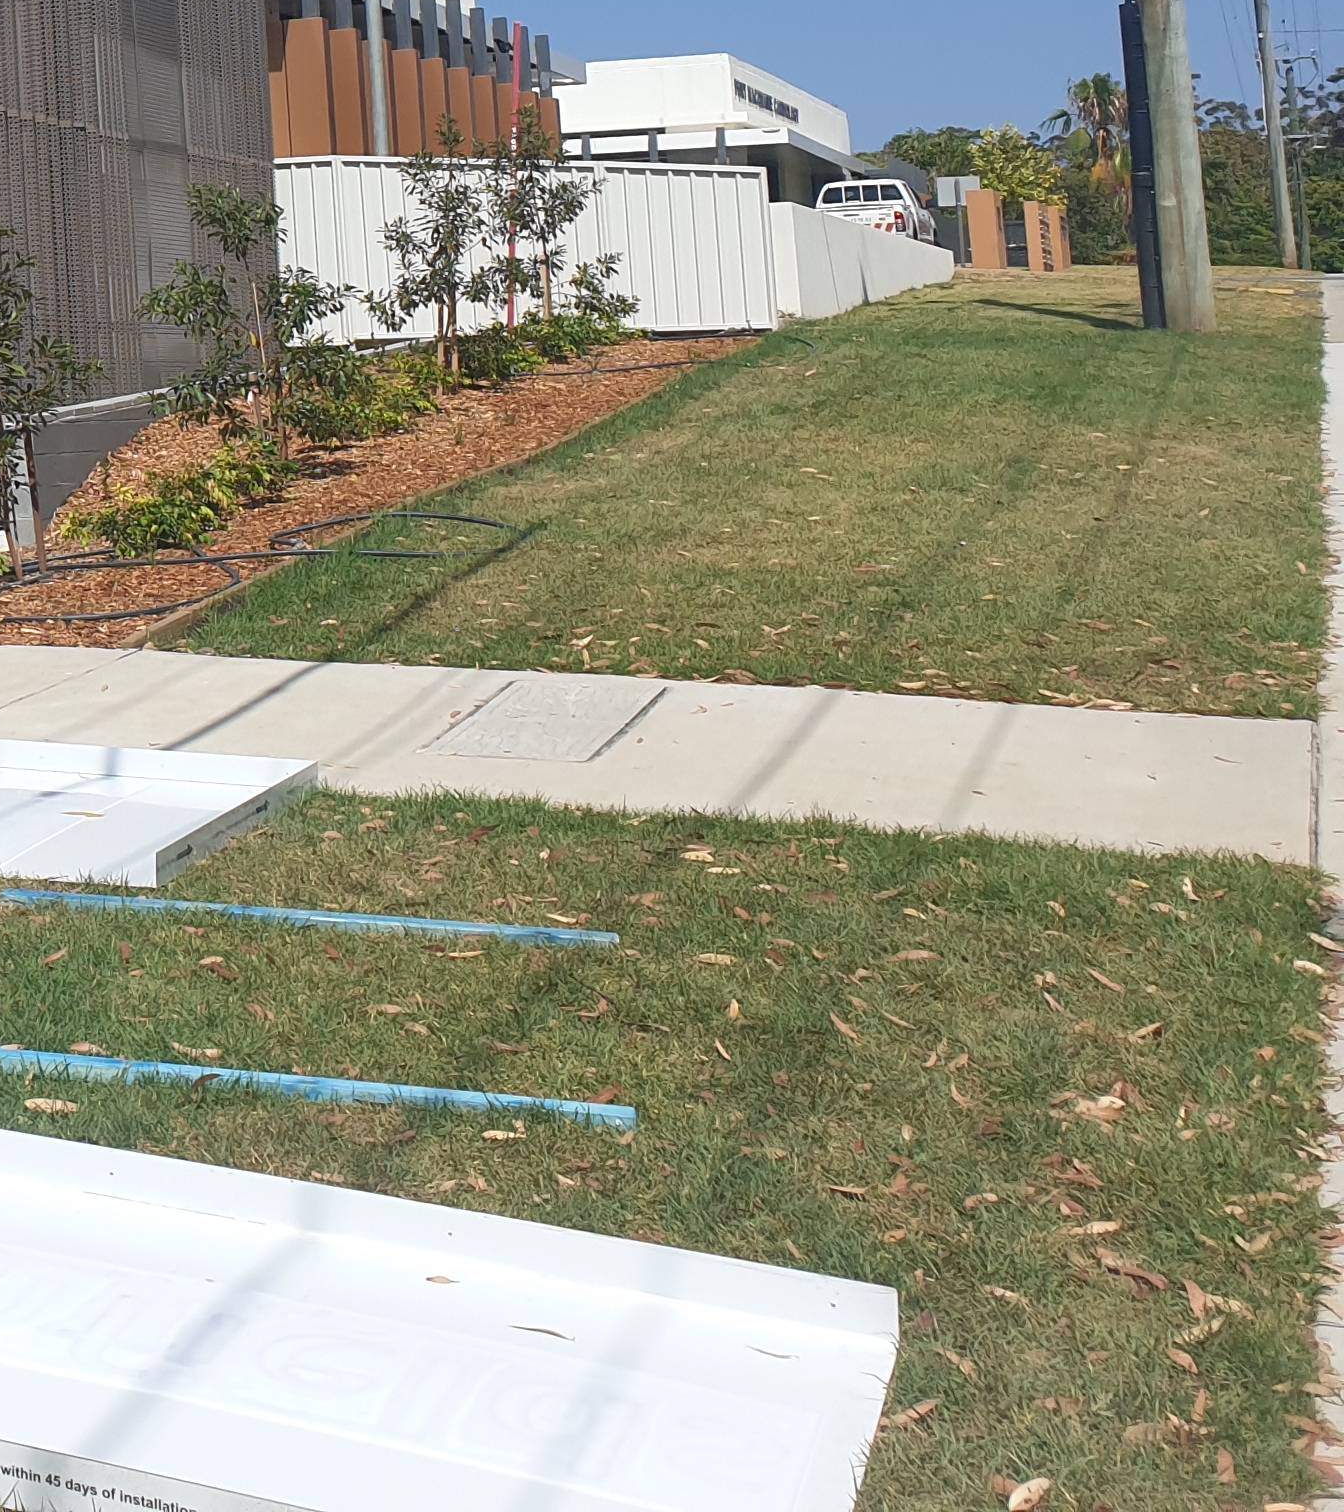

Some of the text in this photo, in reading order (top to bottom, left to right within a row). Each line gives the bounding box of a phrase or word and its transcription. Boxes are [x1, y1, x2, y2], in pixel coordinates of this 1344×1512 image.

[1, 1465, 41, 1484] within
[45, 1472, 61, 1488] 45
[65, 1478, 97, 1498] days
[102, 1487, 117, 1501] of
